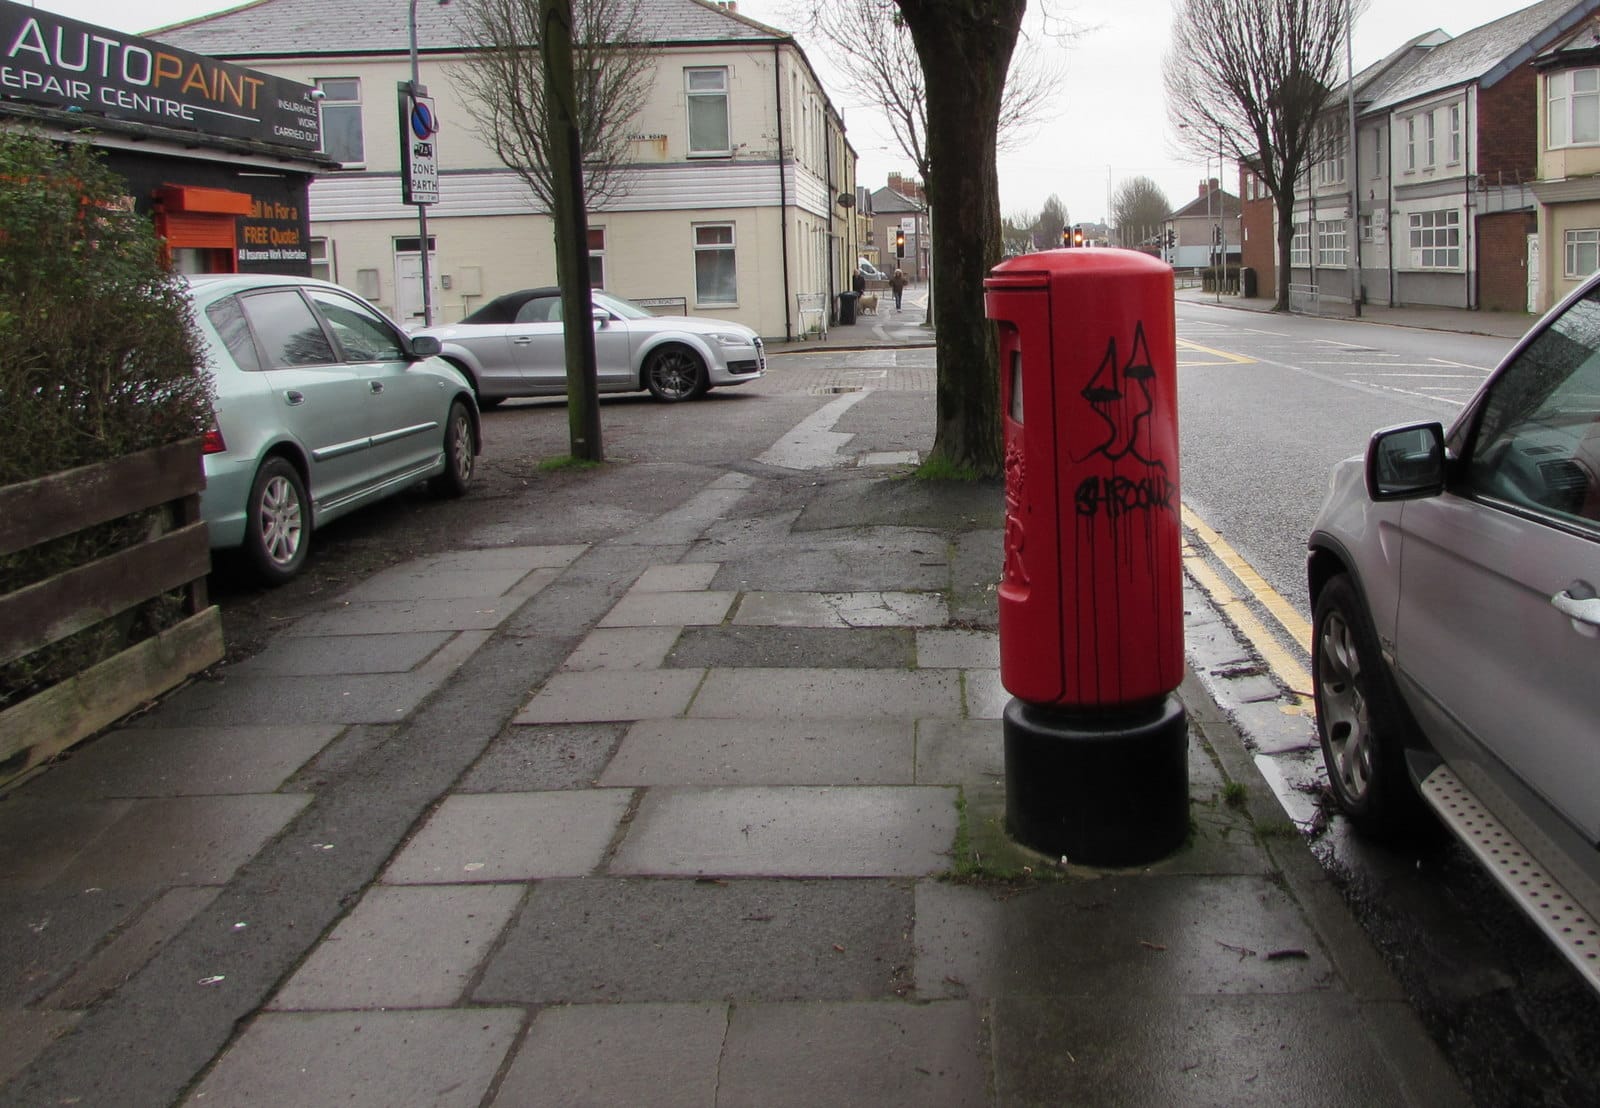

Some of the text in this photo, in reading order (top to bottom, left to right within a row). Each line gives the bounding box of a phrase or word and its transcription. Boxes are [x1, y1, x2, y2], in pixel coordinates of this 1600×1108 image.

[1, 66, 194, 120] EPAIR CENTRE
[278, 99, 317, 117] INSURANCE
[298, 117, 318, 129] WORK
[274, 125, 319, 142] CARRIED OUT
[412, 163, 435, 175] ZONE
[412, 180, 438, 191] PARTH
[249, 201, 298, 220] all In For a
[244, 226, 300, 246] FREE Quote!
[246, 249, 269, 260] Insurance
[269, 249, 282, 260] Work
